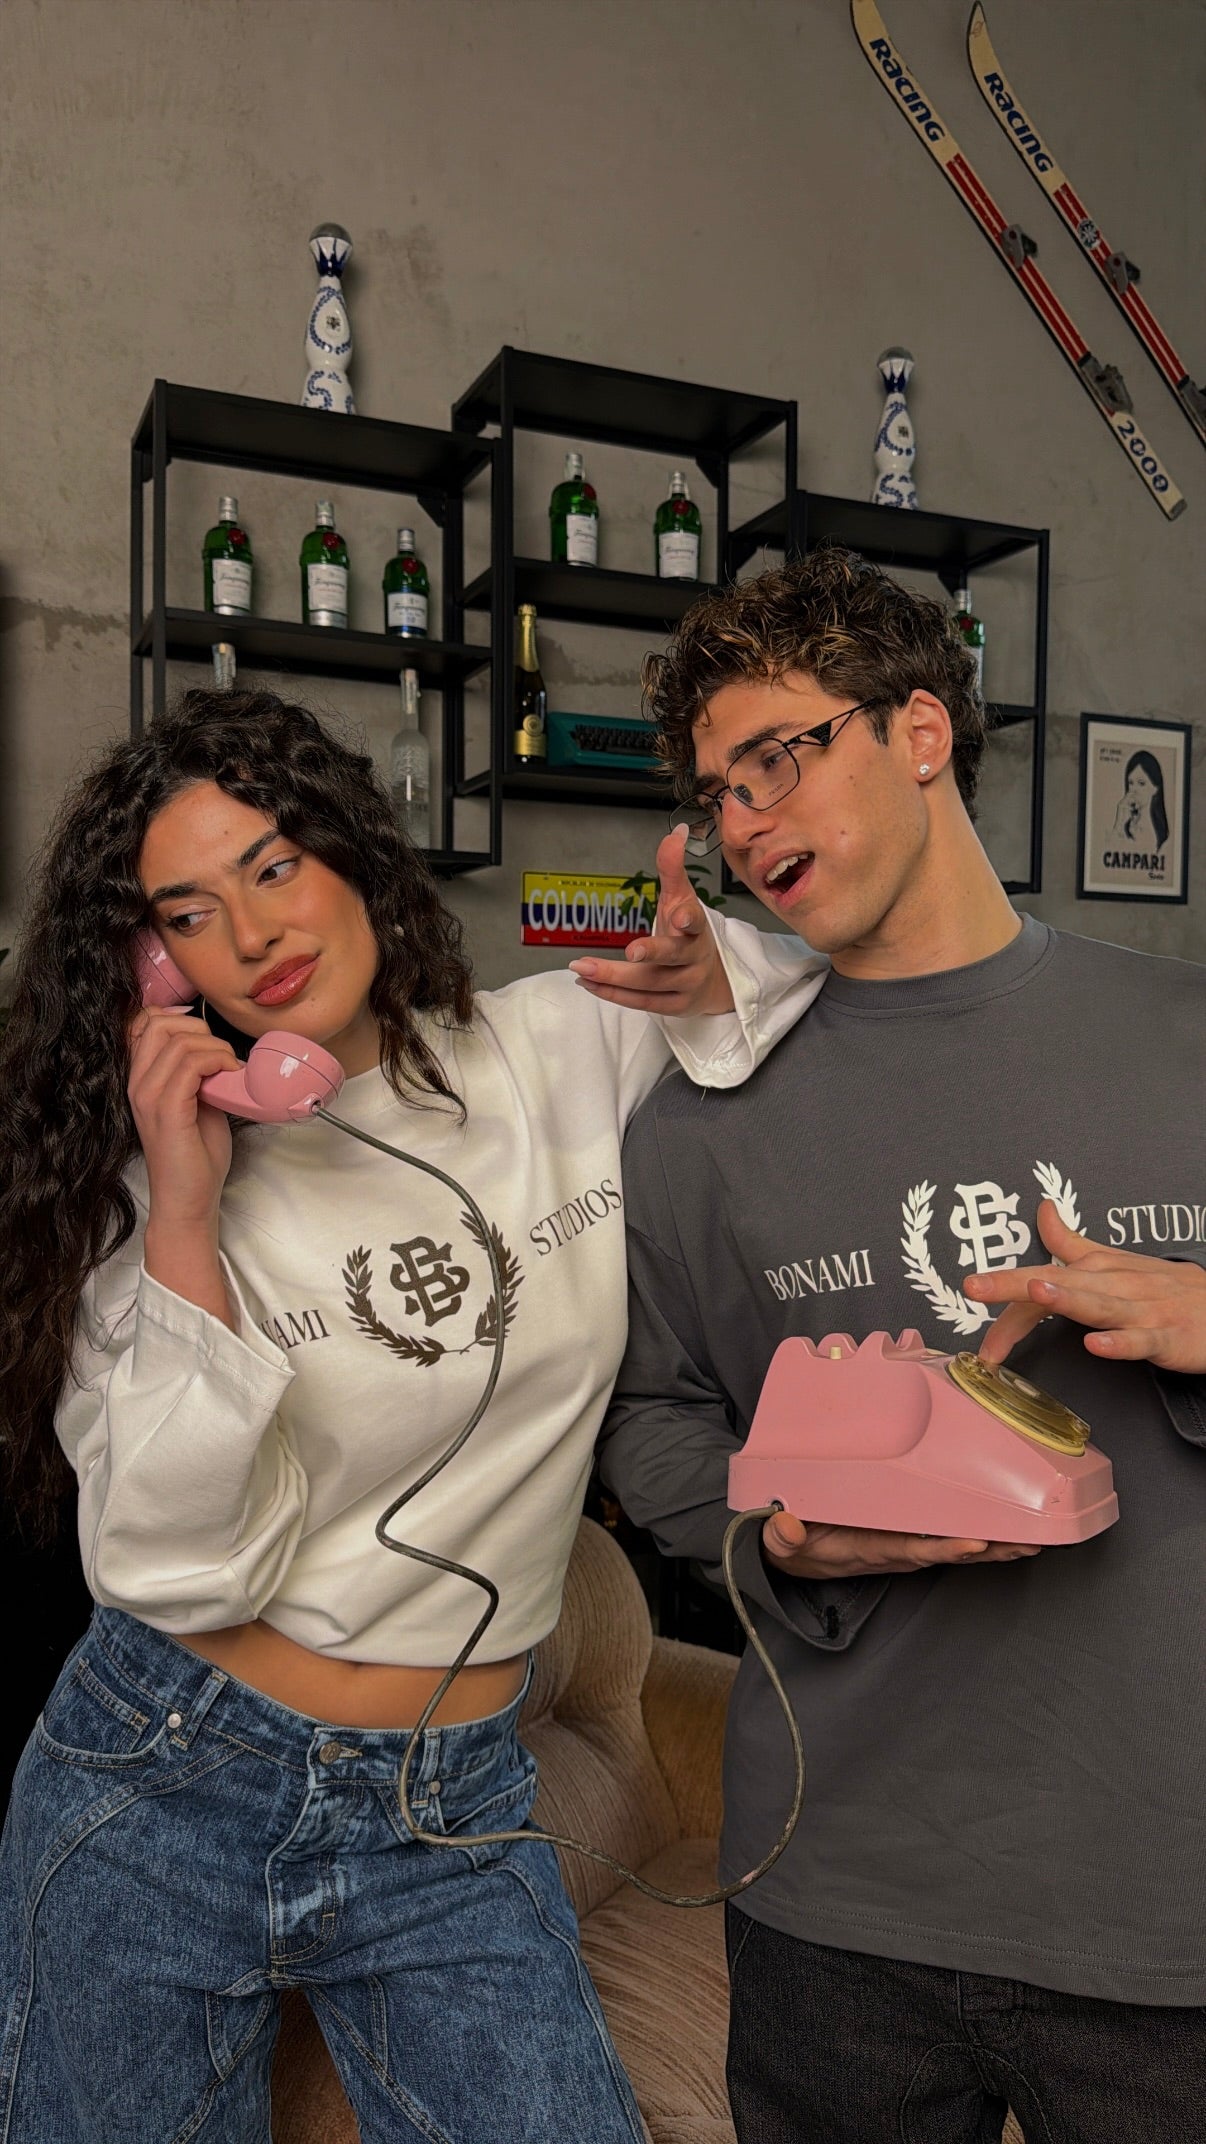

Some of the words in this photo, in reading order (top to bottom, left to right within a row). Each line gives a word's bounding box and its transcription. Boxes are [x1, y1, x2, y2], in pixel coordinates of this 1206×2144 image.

[1117, 419, 1170, 494] 2000
[1103, 851, 1166, 872] CAMPARI
[527, 888, 651, 934] COLOMBIA
[529, 1179, 623, 1257] STUDIOS
[763, 1248, 876, 1301] BONAMI
[1107, 1204, 1206, 1246] STUDI
